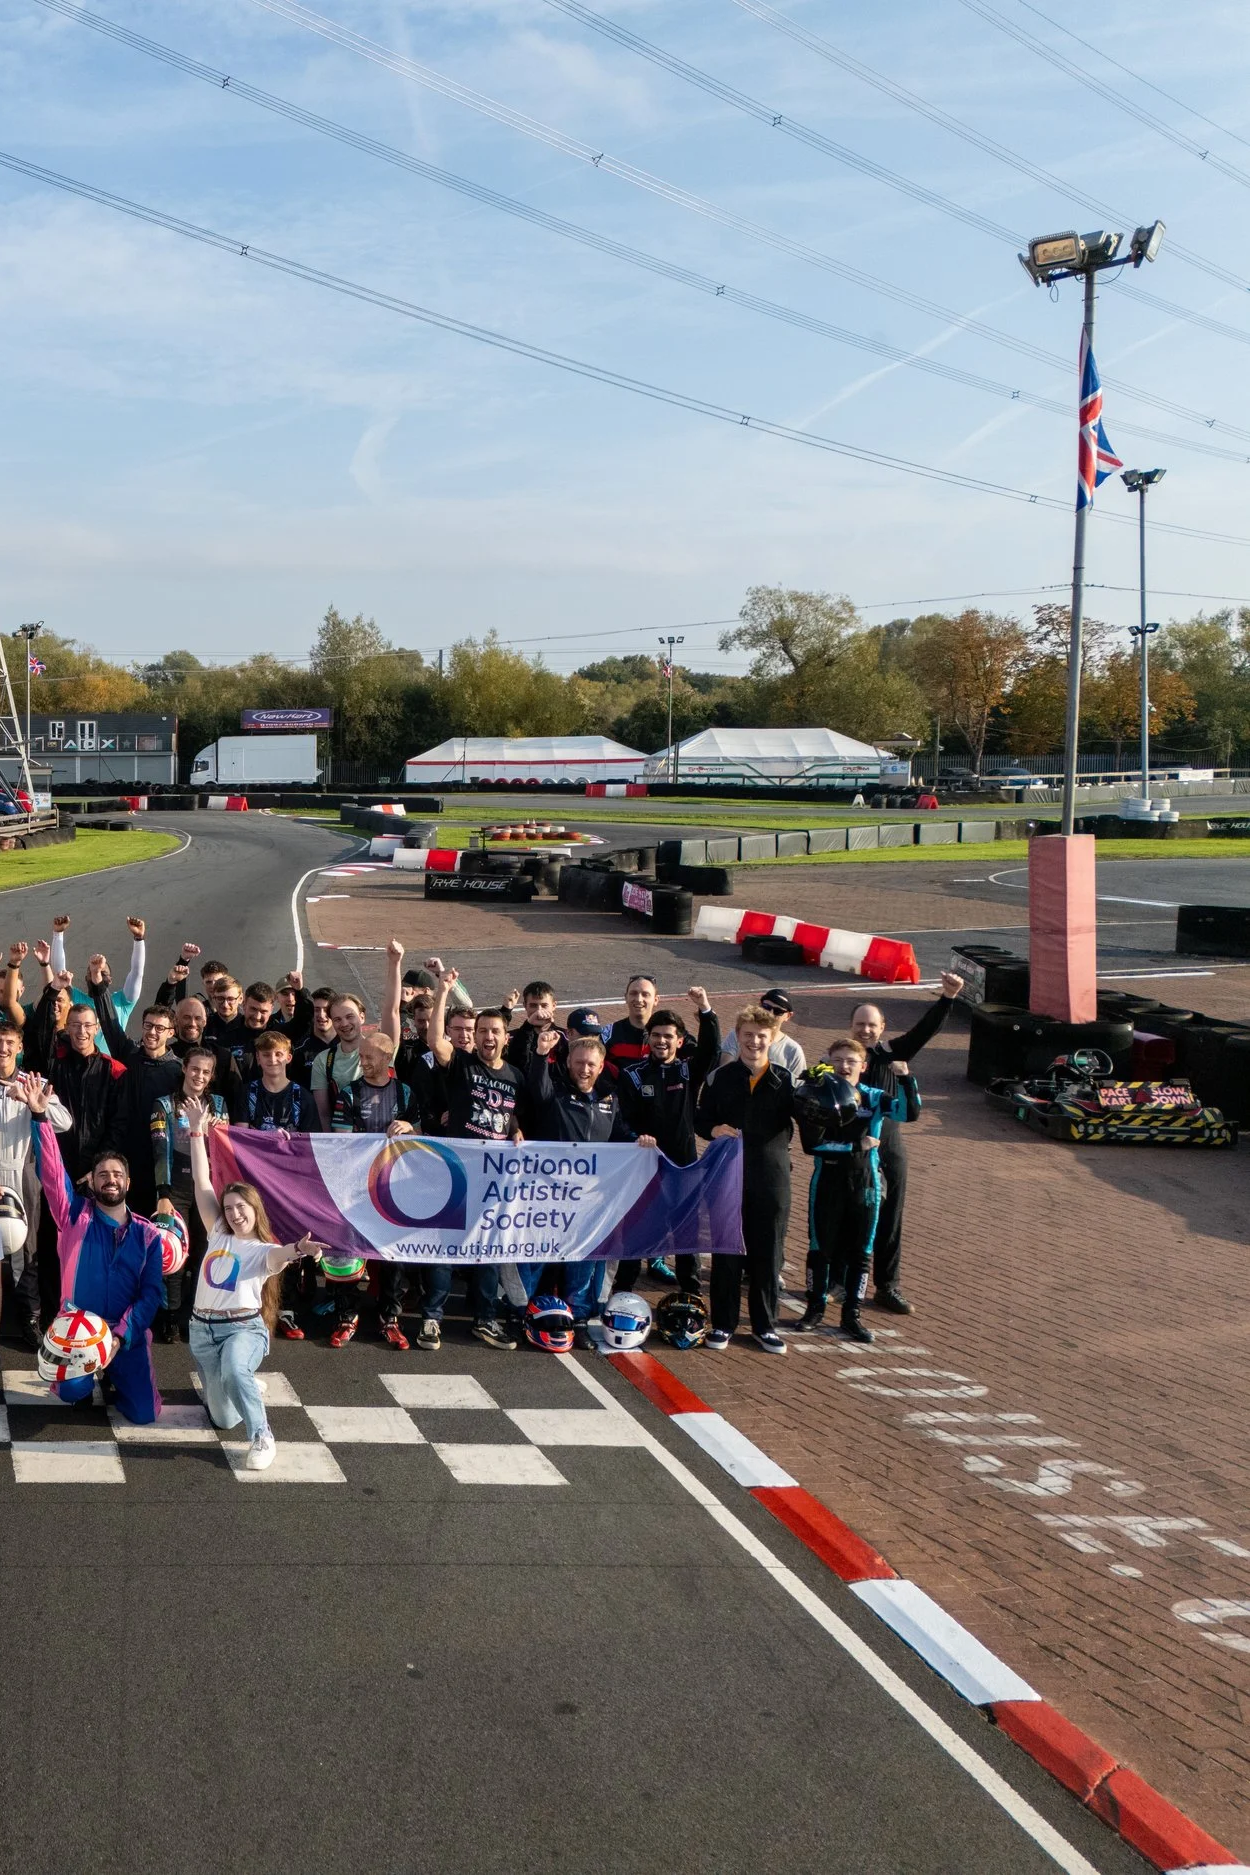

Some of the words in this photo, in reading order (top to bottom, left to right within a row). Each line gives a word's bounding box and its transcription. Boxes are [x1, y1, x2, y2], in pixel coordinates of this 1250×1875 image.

[433, 878, 461, 888] RYE
[463, 879, 510, 890] HOUSE
[1100, 1087, 1129, 1097] PACE
[1151, 1086, 1185, 1096] SLOW
[1102, 1097, 1132, 1106] KART
[1151, 1095, 1191, 1105] DOWN
[483, 1152, 597, 1175] National
[482, 1180, 583, 1203] Autistic
[481, 1207, 576, 1232] Society
[396, 1238, 560, 1258] www.autism.org.uk
